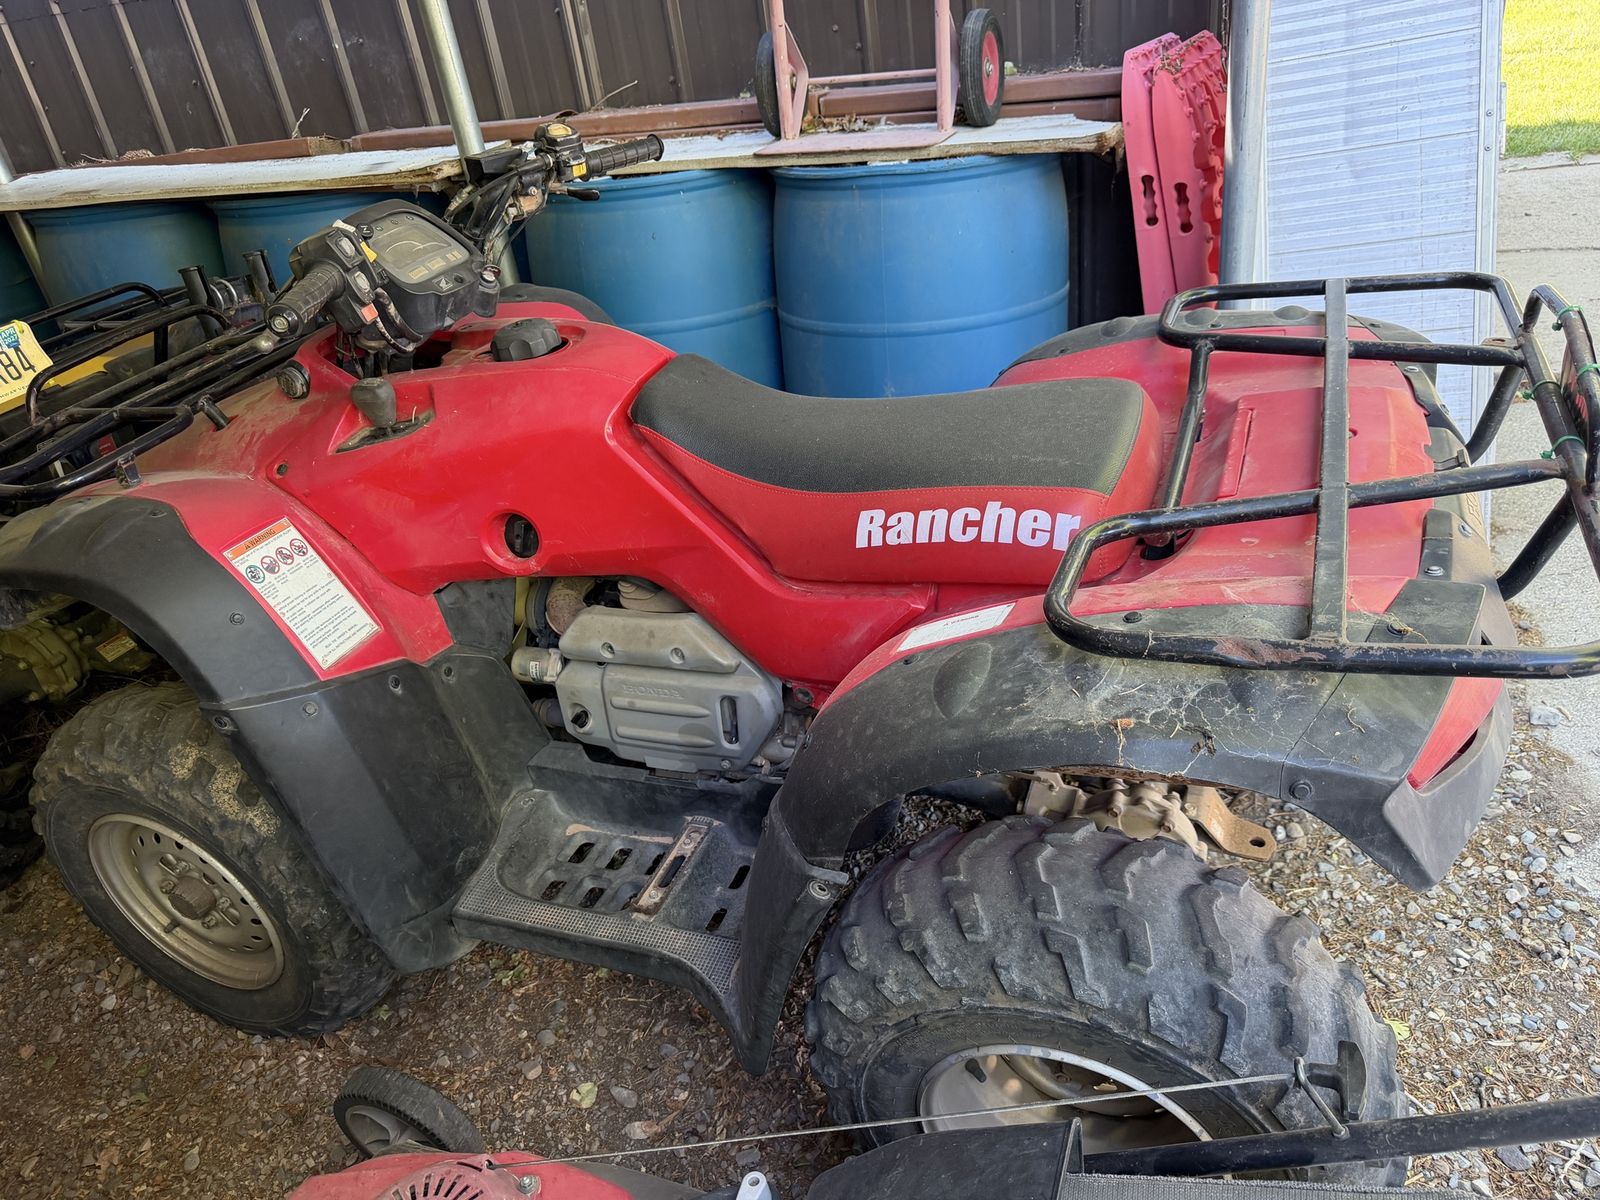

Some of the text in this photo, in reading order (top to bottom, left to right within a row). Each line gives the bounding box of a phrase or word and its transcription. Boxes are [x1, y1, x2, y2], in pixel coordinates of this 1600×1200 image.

[1, 327, 16, 338] APR
[856, 501, 1080, 551] Rancher
[249, 528, 276, 547] WARNING
[624, 684, 685, 699] HONDA
